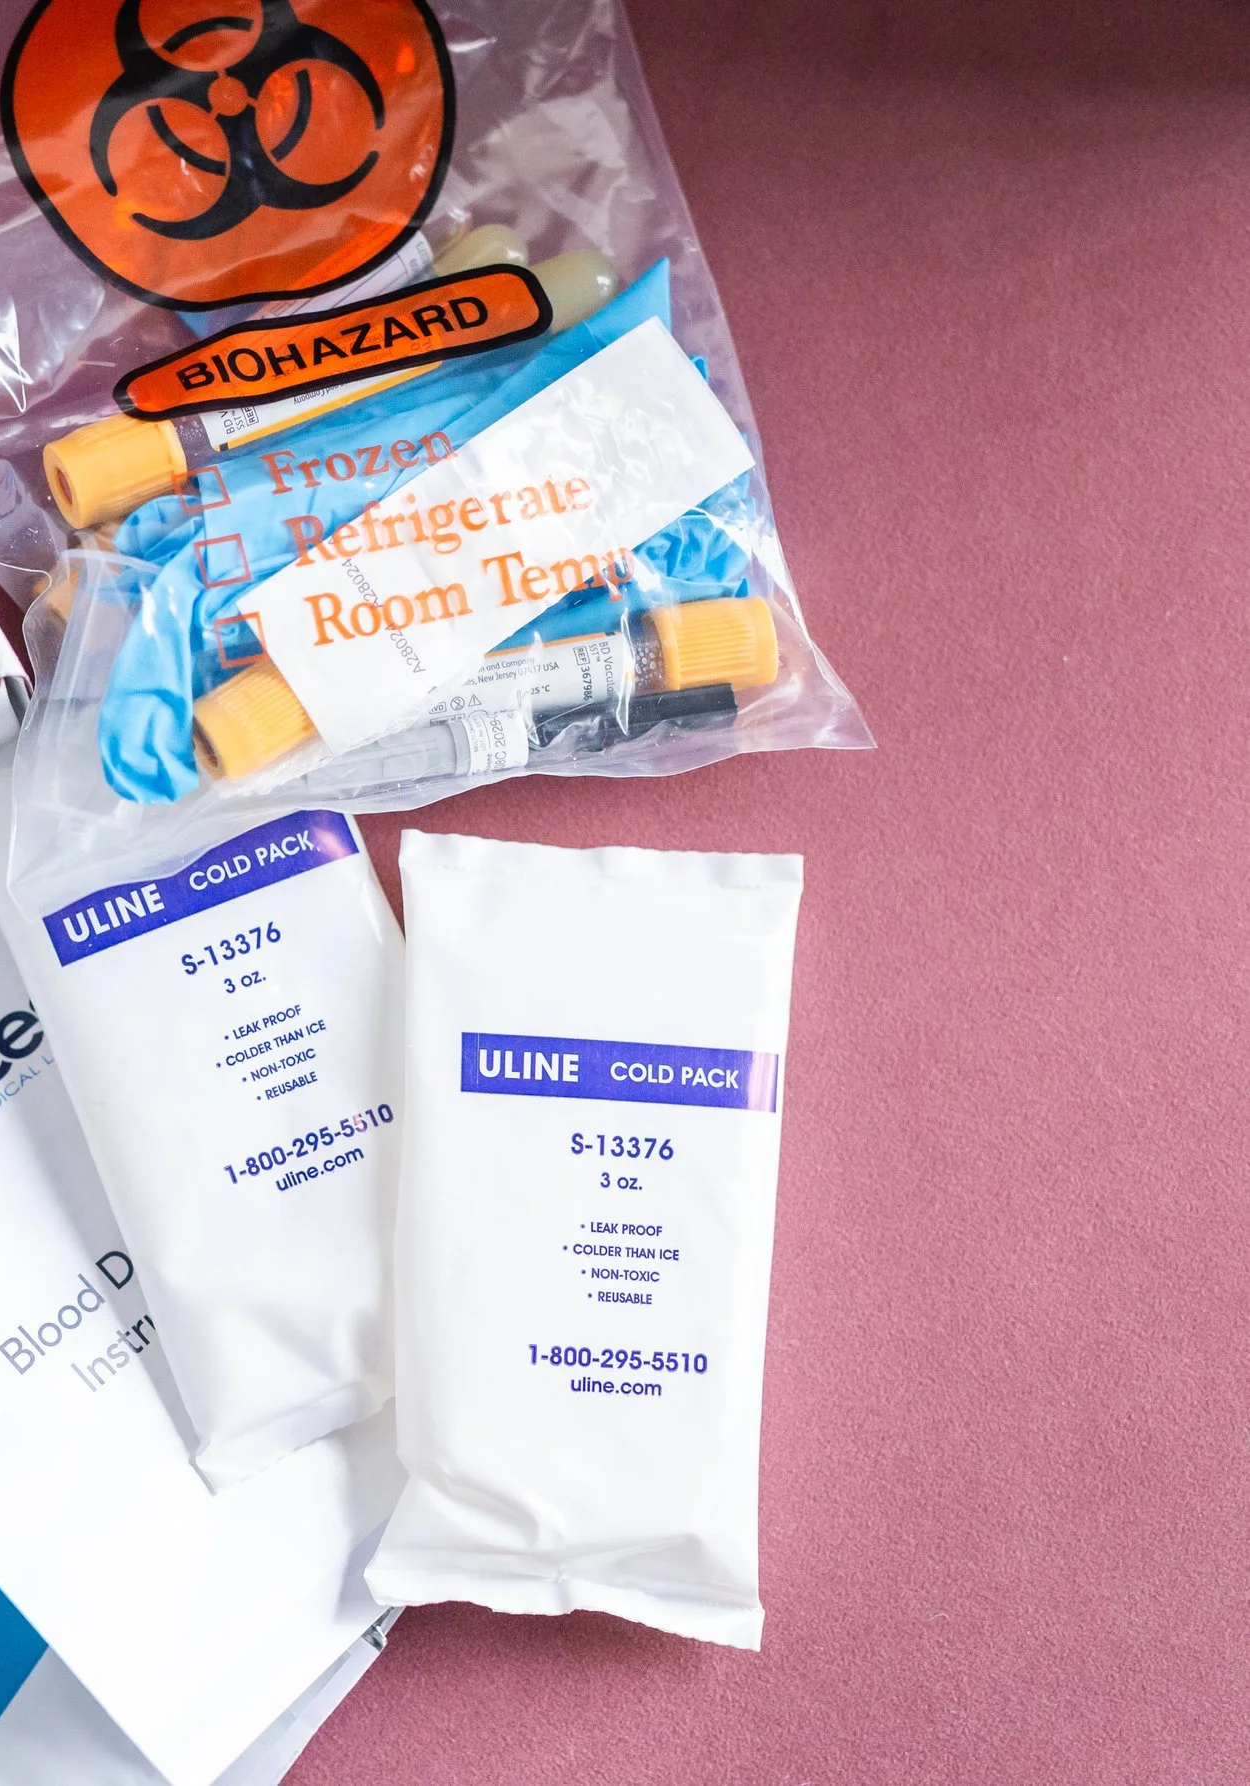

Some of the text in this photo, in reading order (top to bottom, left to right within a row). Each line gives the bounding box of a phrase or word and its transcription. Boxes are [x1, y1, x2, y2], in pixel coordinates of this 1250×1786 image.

[177, 296, 489, 391] BIOHAZARD
[224, 420, 235, 434] BD
[260, 428, 458, 496] Frozen
[285, 474, 592, 569] Refrigerate
[305, 546, 636, 647] Room Temp
[599, 641, 611, 655] BD
[478, 675, 494, 683] New
[495, 671, 517, 680] Jersey
[543, 662, 560, 672] USA
[62, 830, 315, 943] ULINE COLD PACK
[181, 921, 282, 975] S-13376
[224, 969, 266, 994] 3 oz.
[232, 1004, 302, 1040] LEAK PROOF
[225, 1019, 327, 1067] COLDER THAN ICE
[250, 1047, 316, 1082] NON-TOXIC
[478, 1048, 740, 1090] ULINE COLD PACK
[265, 1071, 318, 1100] REUSABLE
[223, 1103, 395, 1185] 1-800-295-5510
[570, 1132, 674, 1161] S-13376
[276, 1146, 365, 1192] uline.com
[599, 1172, 643, 1191] 3 oz.
[590, 1221, 663, 1237] LEAK PROOF
[573, 1243, 680, 1261] COLDER THAN ICE
[590, 1268, 661, 1283] NON-TOXIC
[597, 1290, 653, 1305] REUSABLE
[528, 1344, 708, 1374] 1-800-295-5510
[570, 1377, 662, 1396] uline.com
